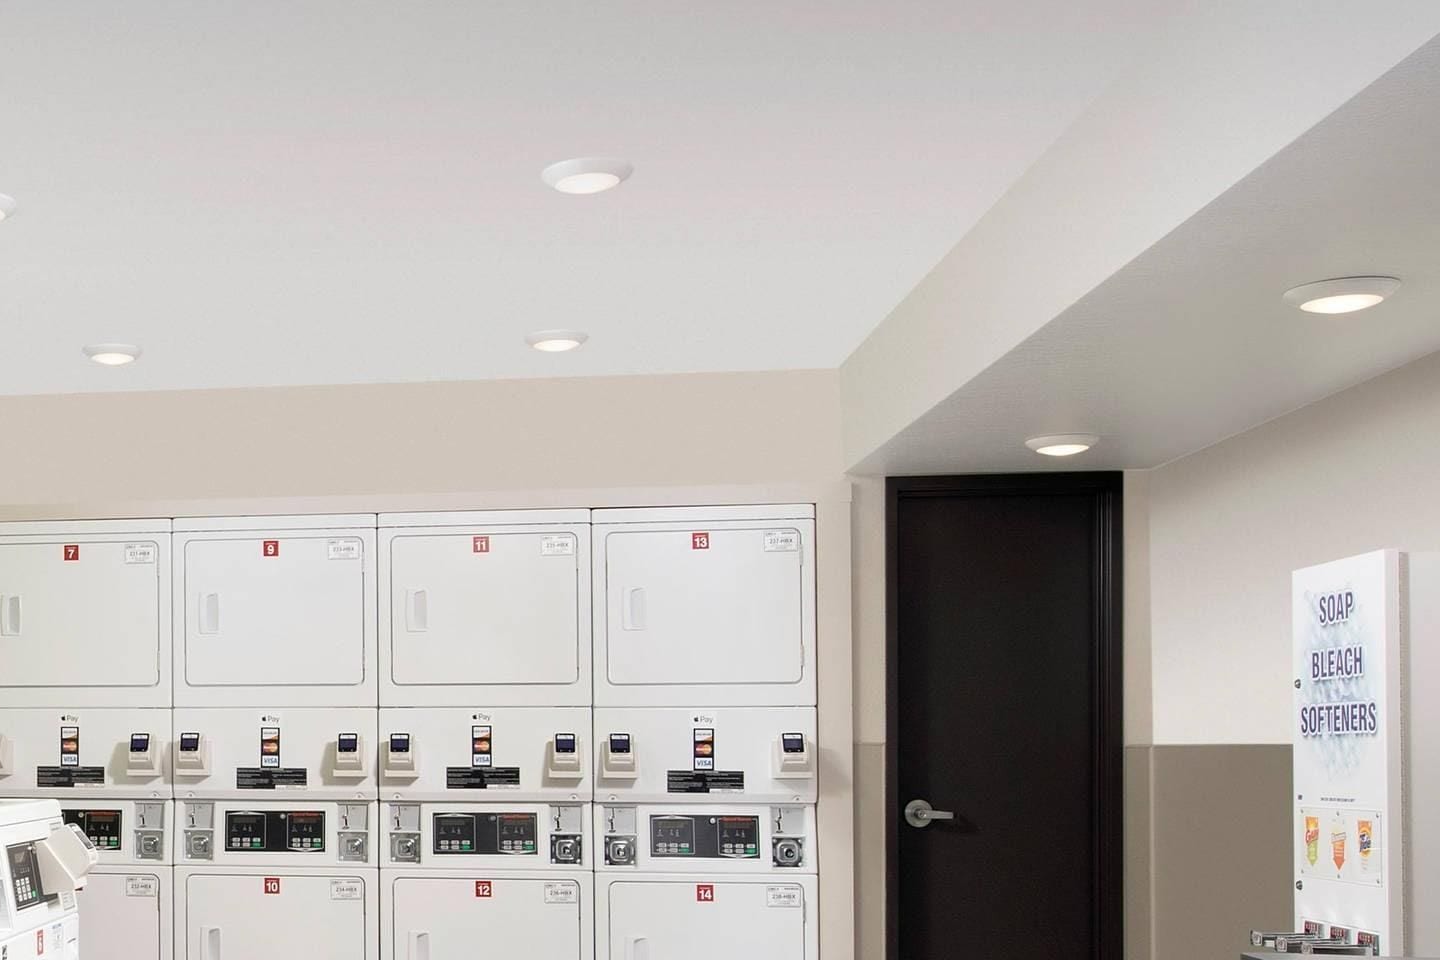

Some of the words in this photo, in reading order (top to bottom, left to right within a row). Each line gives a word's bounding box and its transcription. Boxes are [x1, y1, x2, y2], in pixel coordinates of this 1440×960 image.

[476, 541, 486, 551] 11
[695, 538, 707, 547] 13
[267, 545, 274, 554] 9
[68, 550, 74, 559] 7
[1320, 591, 1353, 623] SOAP
[1312, 647, 1362, 678] BLEACH
[1301, 702, 1376, 735] SOFTENERS
[266, 883, 277, 892] 10
[478, 886, 489, 895] 12
[699, 890, 712, 900] 14
